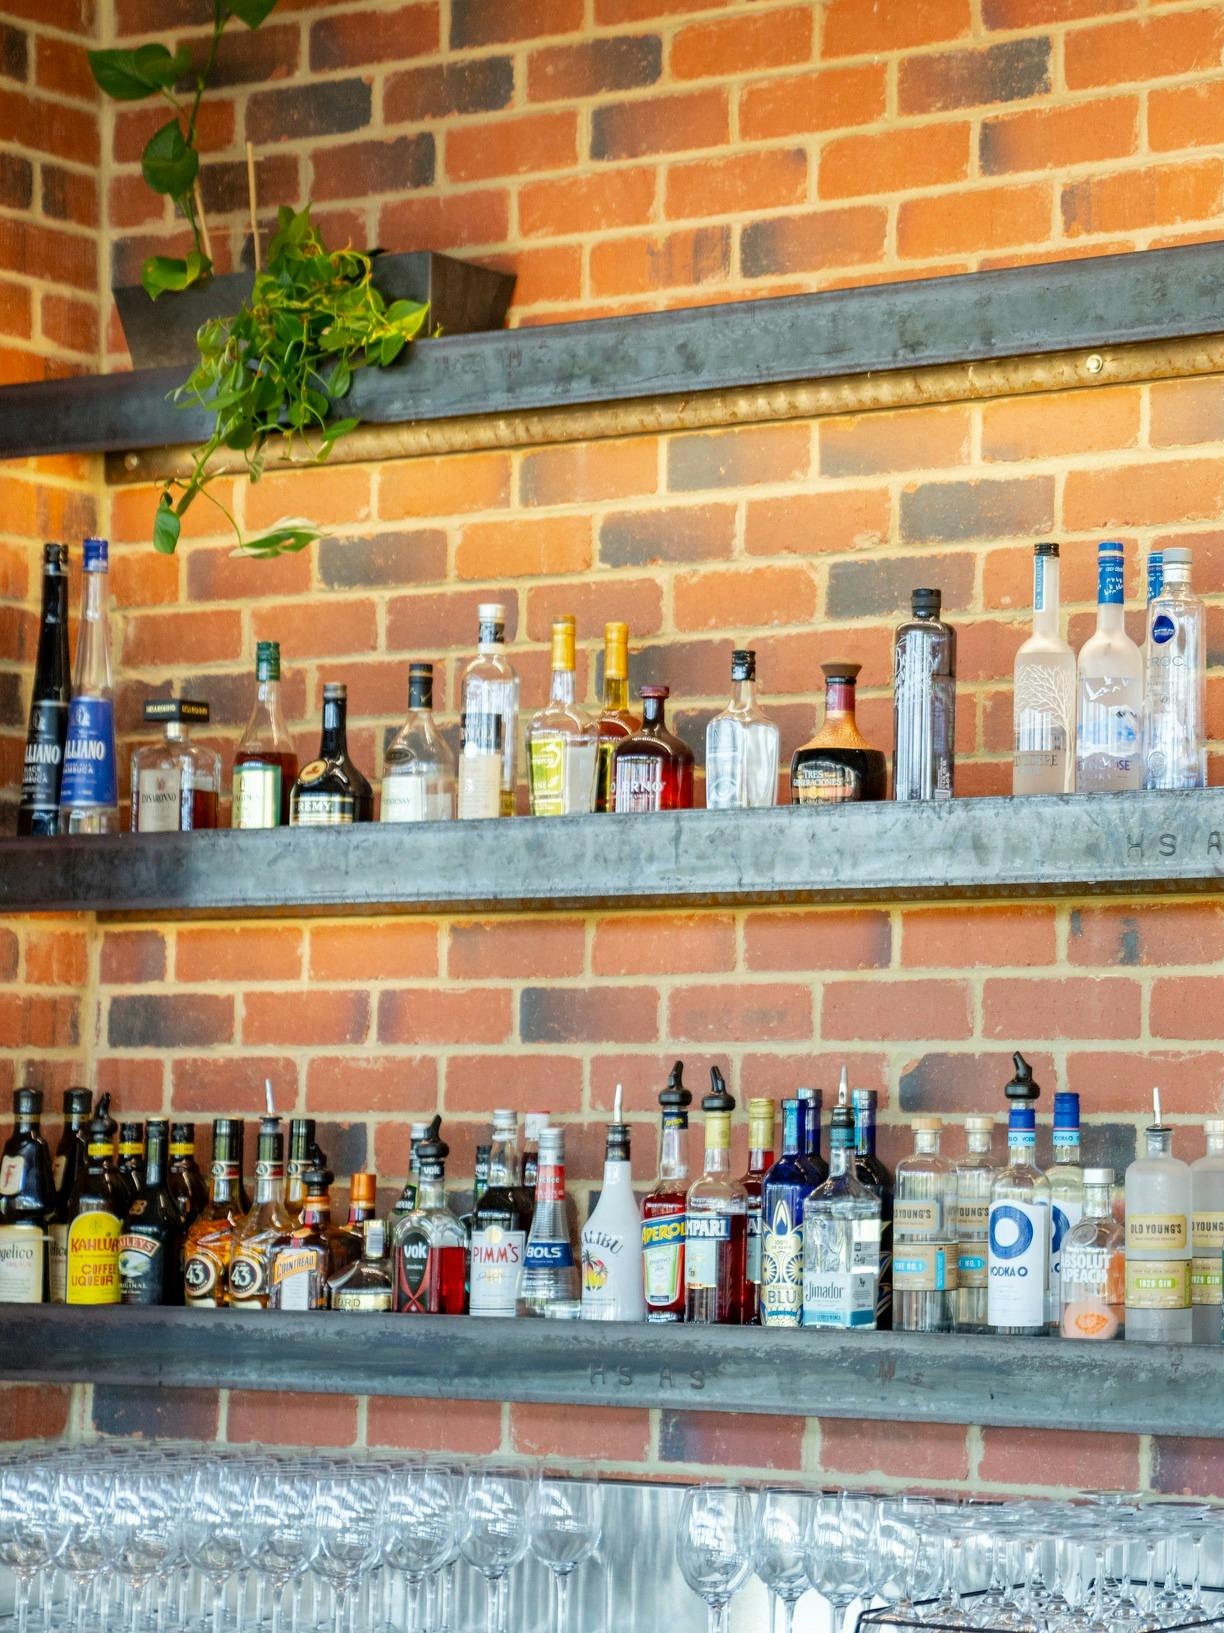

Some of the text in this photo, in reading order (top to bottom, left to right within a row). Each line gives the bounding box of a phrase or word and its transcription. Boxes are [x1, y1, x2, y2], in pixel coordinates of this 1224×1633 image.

[1146, 1223, 1182, 1235] YOUNG'S
[404, 1241, 427, 1259] vok
[474, 1242, 519, 1264] PIMM'S
[526, 1246, 562, 1258] BOLS
[186, 1264, 205, 1285] 43
[278, 1255, 315, 1277] COINTREAU
[71, 1274, 114, 1287] LIQUEUR
[231, 1265, 252, 1287] 43
[768, 1290, 797, 1304] BLU
[806, 1281, 844, 1302] Jimador
